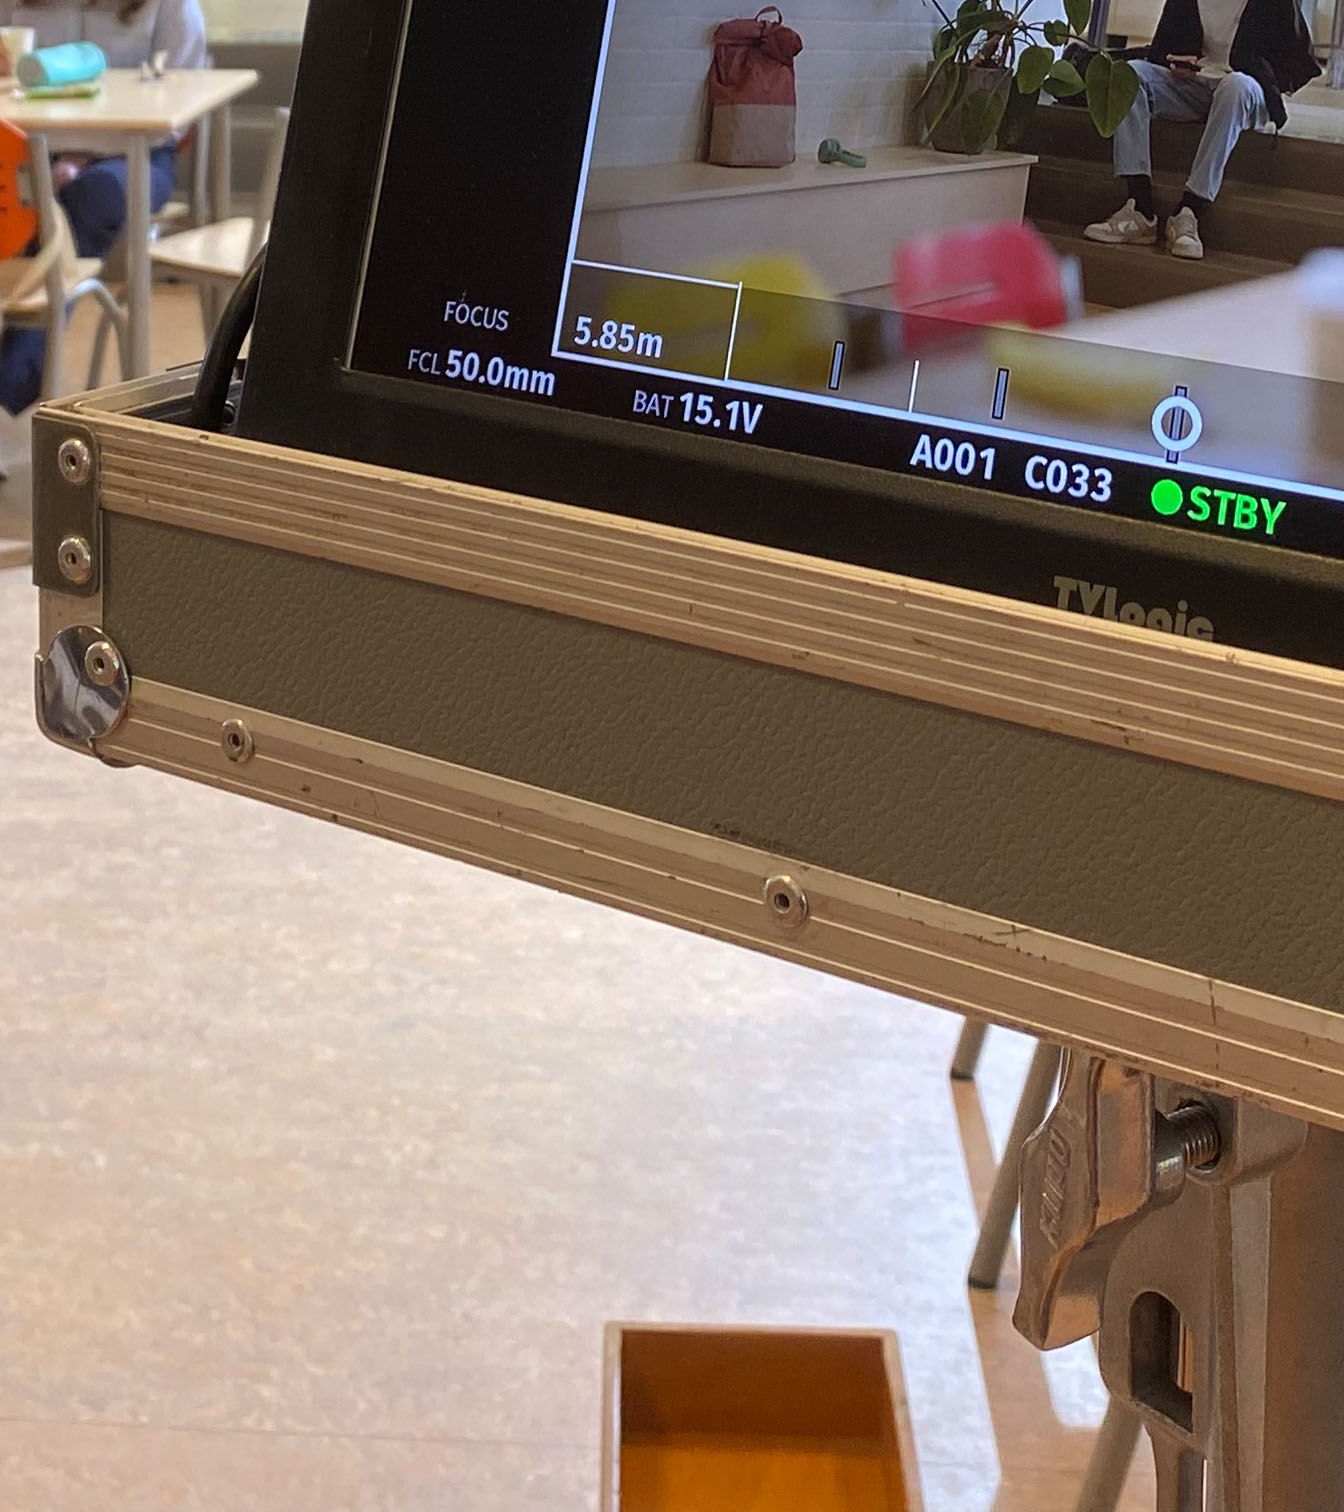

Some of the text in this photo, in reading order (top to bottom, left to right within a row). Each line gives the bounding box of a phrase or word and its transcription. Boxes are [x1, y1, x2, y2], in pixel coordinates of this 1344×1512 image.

[444, 301, 509, 331] FOCUS
[573, 316, 663, 359] 5.85m
[408, 349, 555, 397] FCL 50.0mm
[633, 390, 763, 435] BAT 15.1V
[909, 433, 1288, 536] A001 C033 STBY
